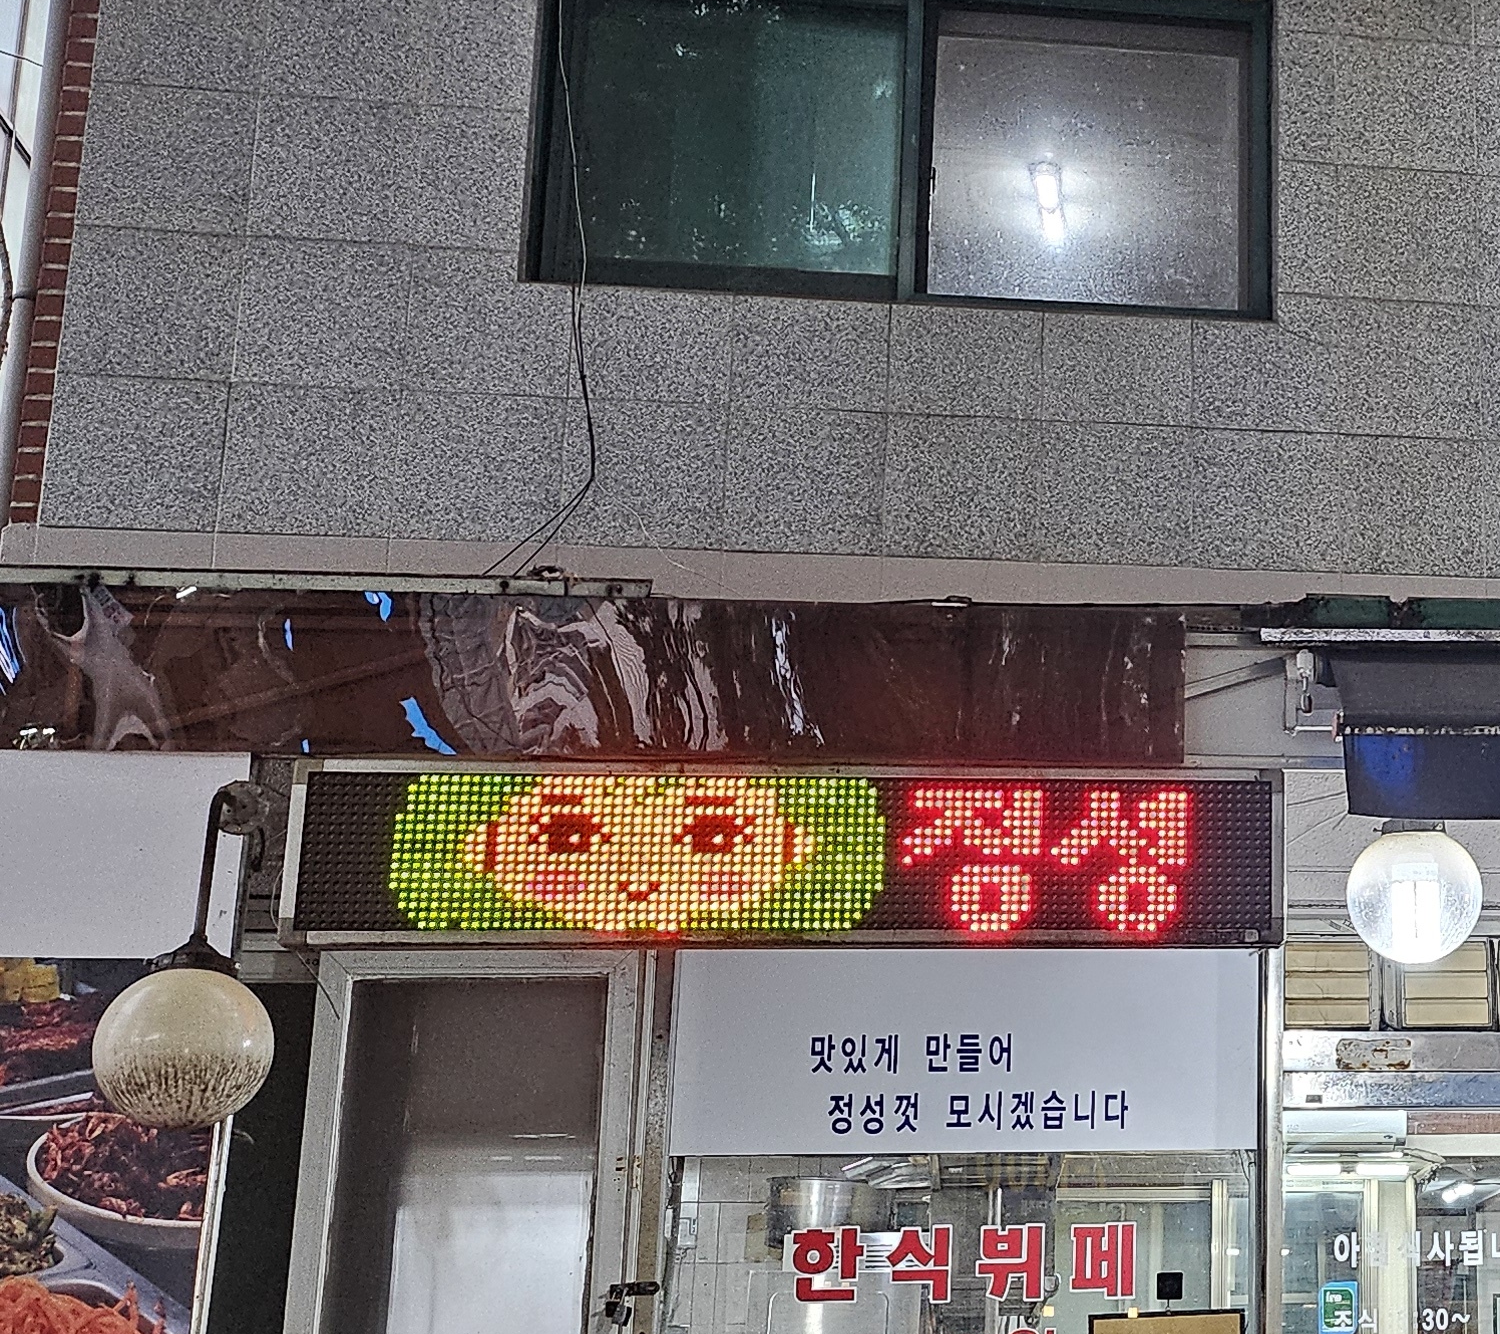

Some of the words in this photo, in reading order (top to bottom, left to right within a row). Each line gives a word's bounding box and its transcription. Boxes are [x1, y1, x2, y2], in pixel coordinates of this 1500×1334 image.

[898, 785, 1194, 935] 정성
[808, 1033, 901, 1075] 맛있게
[923, 1032, 1016, 1073] 만들어
[827, 1091, 921, 1137] 정성껏
[945, 1089, 1130, 1131] 모시겠습니다
[790, 1220, 1139, 1305] 한식뷔페
